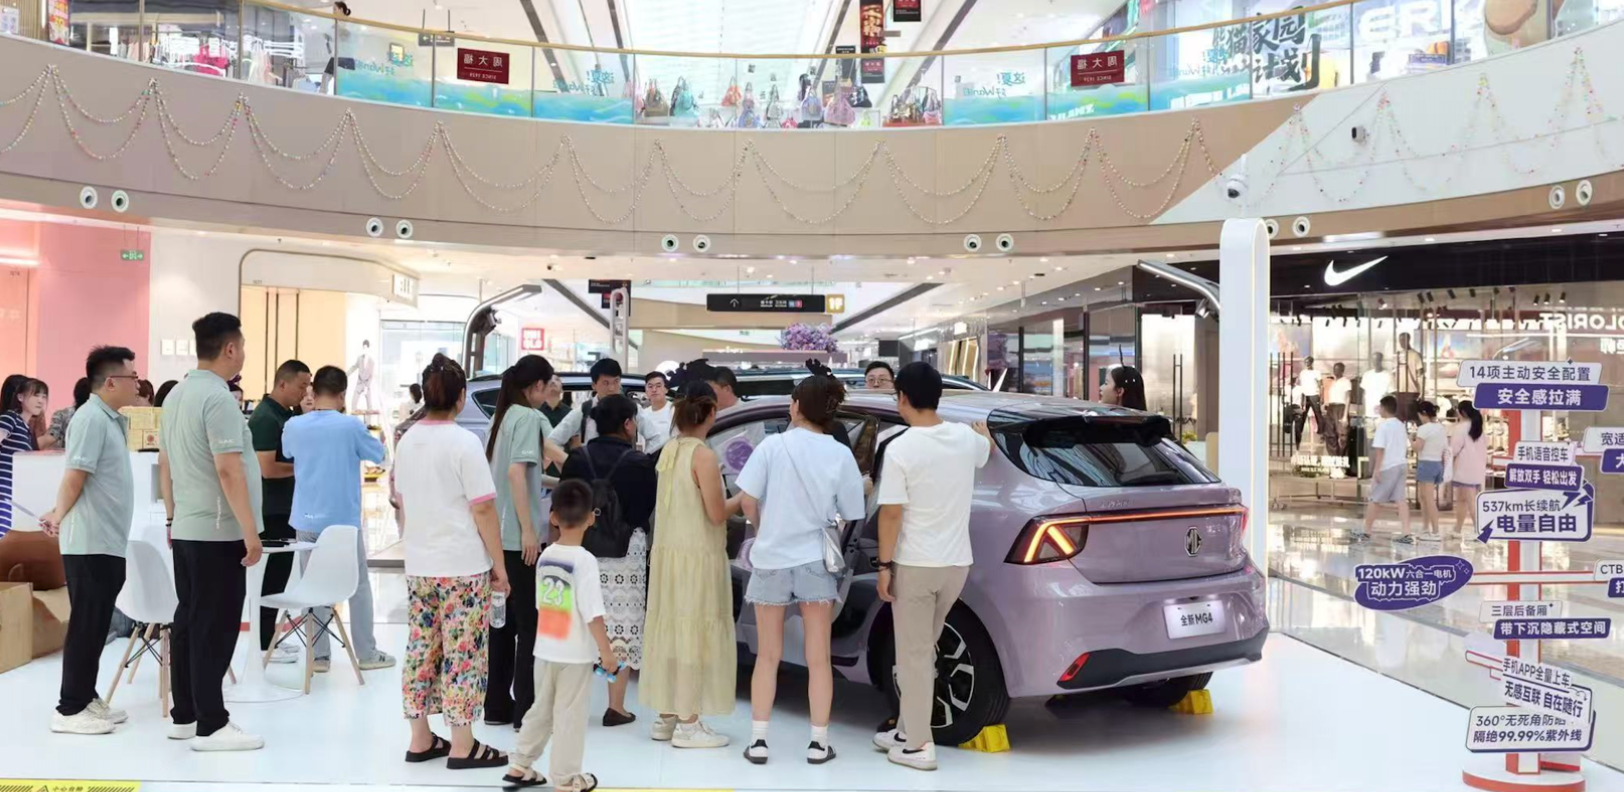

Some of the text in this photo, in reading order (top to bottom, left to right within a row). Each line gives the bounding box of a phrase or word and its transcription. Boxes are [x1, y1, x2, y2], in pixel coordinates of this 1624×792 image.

[1469, 365, 1591, 381] 14项主动安全配置
[1497, 388, 1582, 406] 安全感拉满
[1517, 446, 1569, 462] 手机语音控车
[1509, 468, 1577, 486] 解放双手 轻松出发
[1482, 499, 1561, 512] 537km长续航
[1496, 513, 1577, 533] 电量自由
[1358, 567, 1452, 579] 120kW六合一电机
[543, 577, 566, 607] 23
[1370, 581, 1437, 596] 动力强劲
[1491, 605, 1547, 616] 三层后备厢
[1500, 621, 1606, 635] 带下沉隐藏式空间
[1503, 657, 1571, 687] 手机APP全量上车
[1504, 680, 1583, 718] 无感互联 自在随行
[1473, 729, 1582, 743] 隔绝99.99%紫外线
